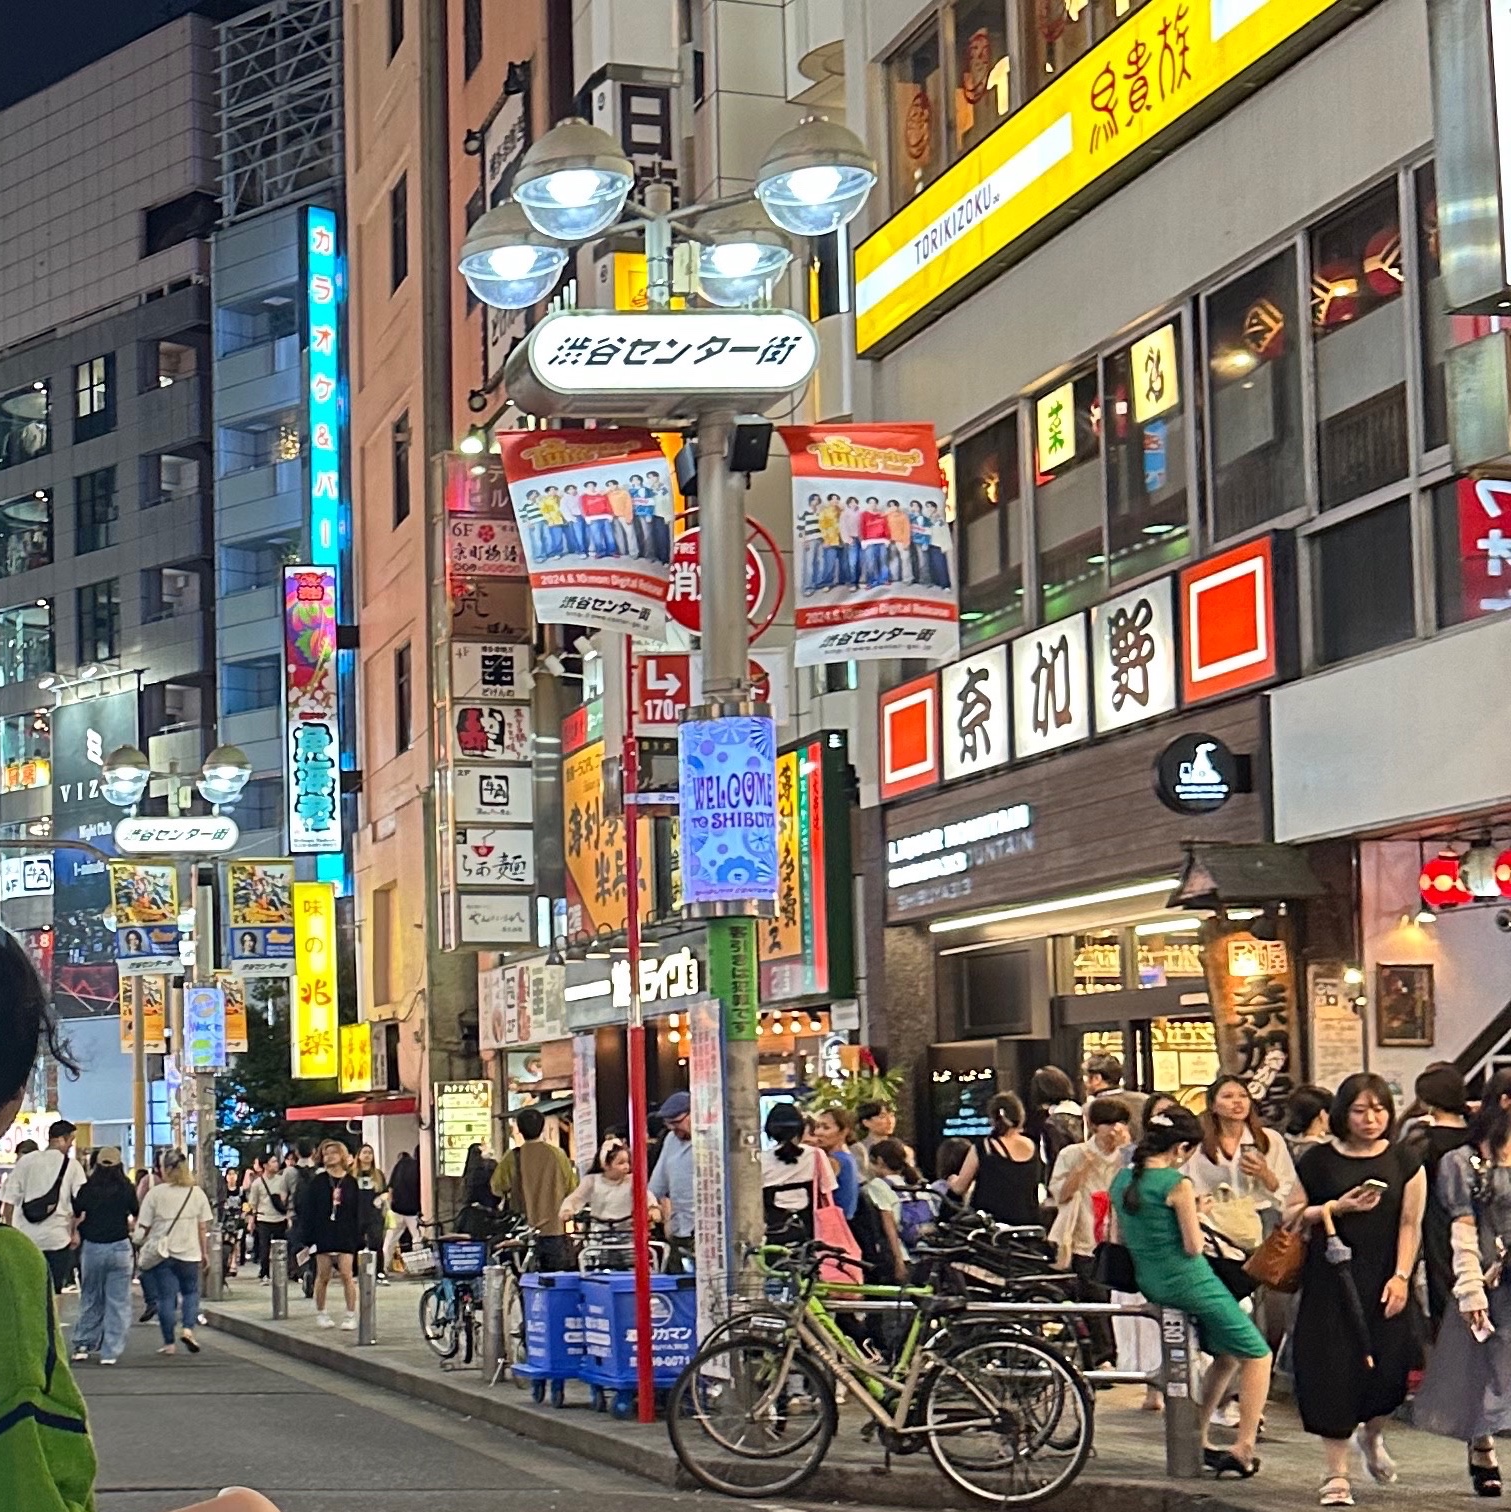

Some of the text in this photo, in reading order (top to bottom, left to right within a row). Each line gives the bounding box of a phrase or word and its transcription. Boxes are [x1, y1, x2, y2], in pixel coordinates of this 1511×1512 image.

[1089, 4, 1194, 155] 鳥貴族
[913, 183, 993, 266] TORIKIZOKU
[547, 335, 802, 367] 渋谷センター街
[559, 595, 652, 622] 渋谷センター街
[819, 626, 936, 649] 渋谷センター街
[956, 598, 1156, 764] 奈加野
[693, 771, 773, 811] WELCOME
[123, 826, 231, 842] 渋谷センター街
[691, 816, 709, 830] TO
